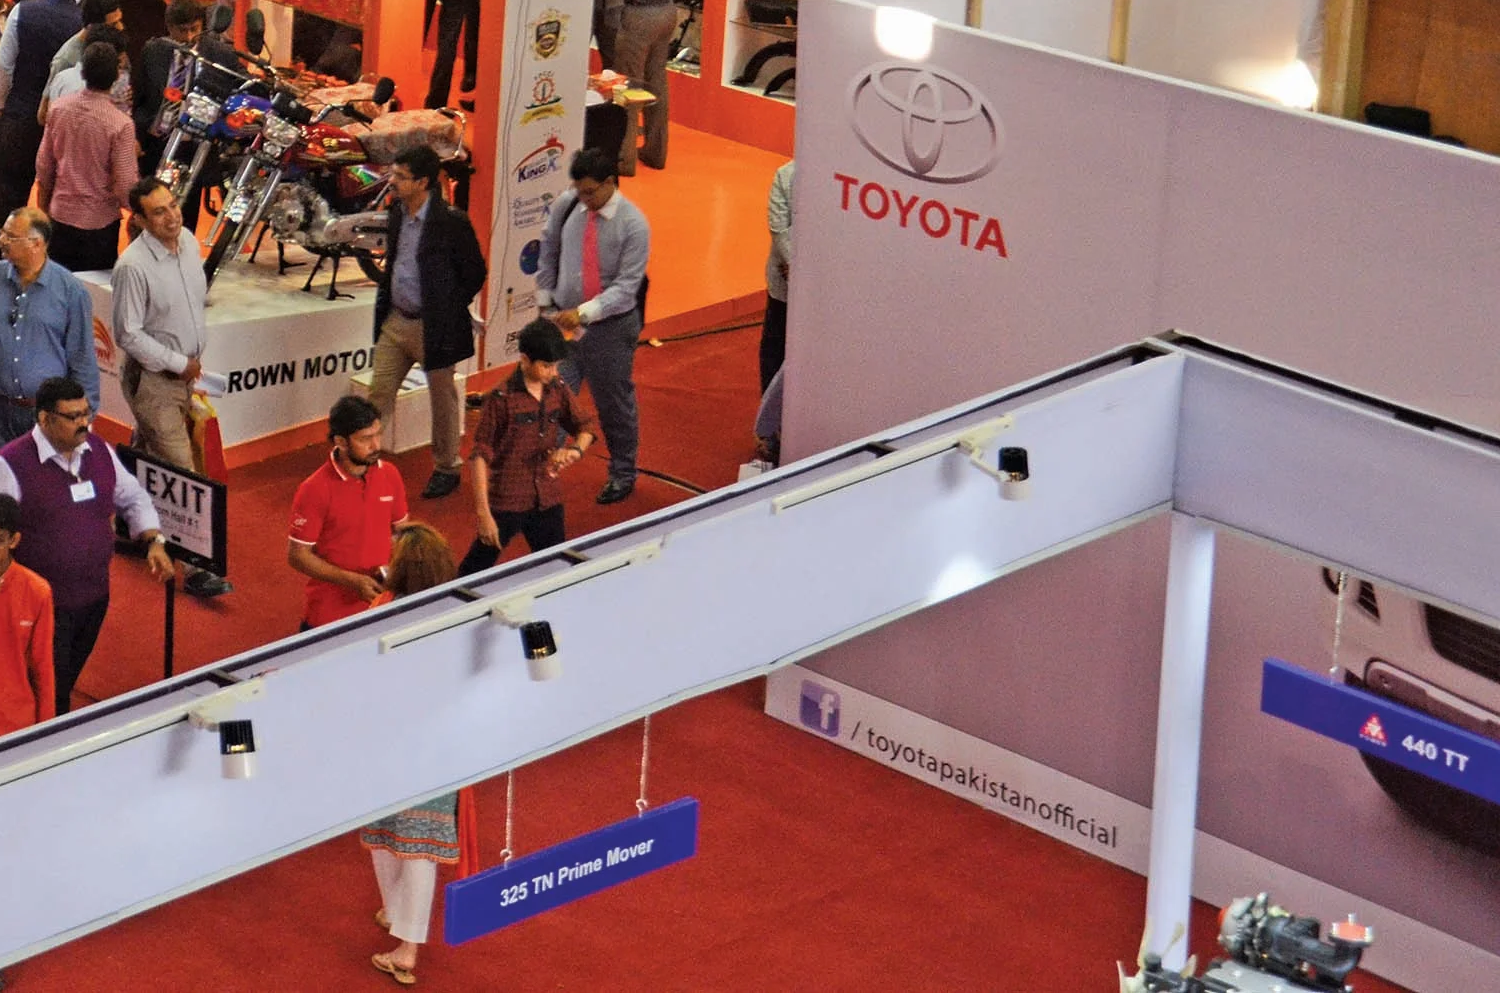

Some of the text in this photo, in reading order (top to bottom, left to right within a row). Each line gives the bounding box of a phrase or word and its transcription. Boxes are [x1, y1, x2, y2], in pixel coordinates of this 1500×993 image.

[833, 171, 1008, 258] TOYOTA
[227, 361, 296, 394] ROWN
[146, 467, 205, 514] EXIT
[1401, 734, 1469, 772] 440 TT
[867, 727, 1117, 848] toyotapakistanofficial
[500, 837, 655, 907] 325 TN Prime Mover
